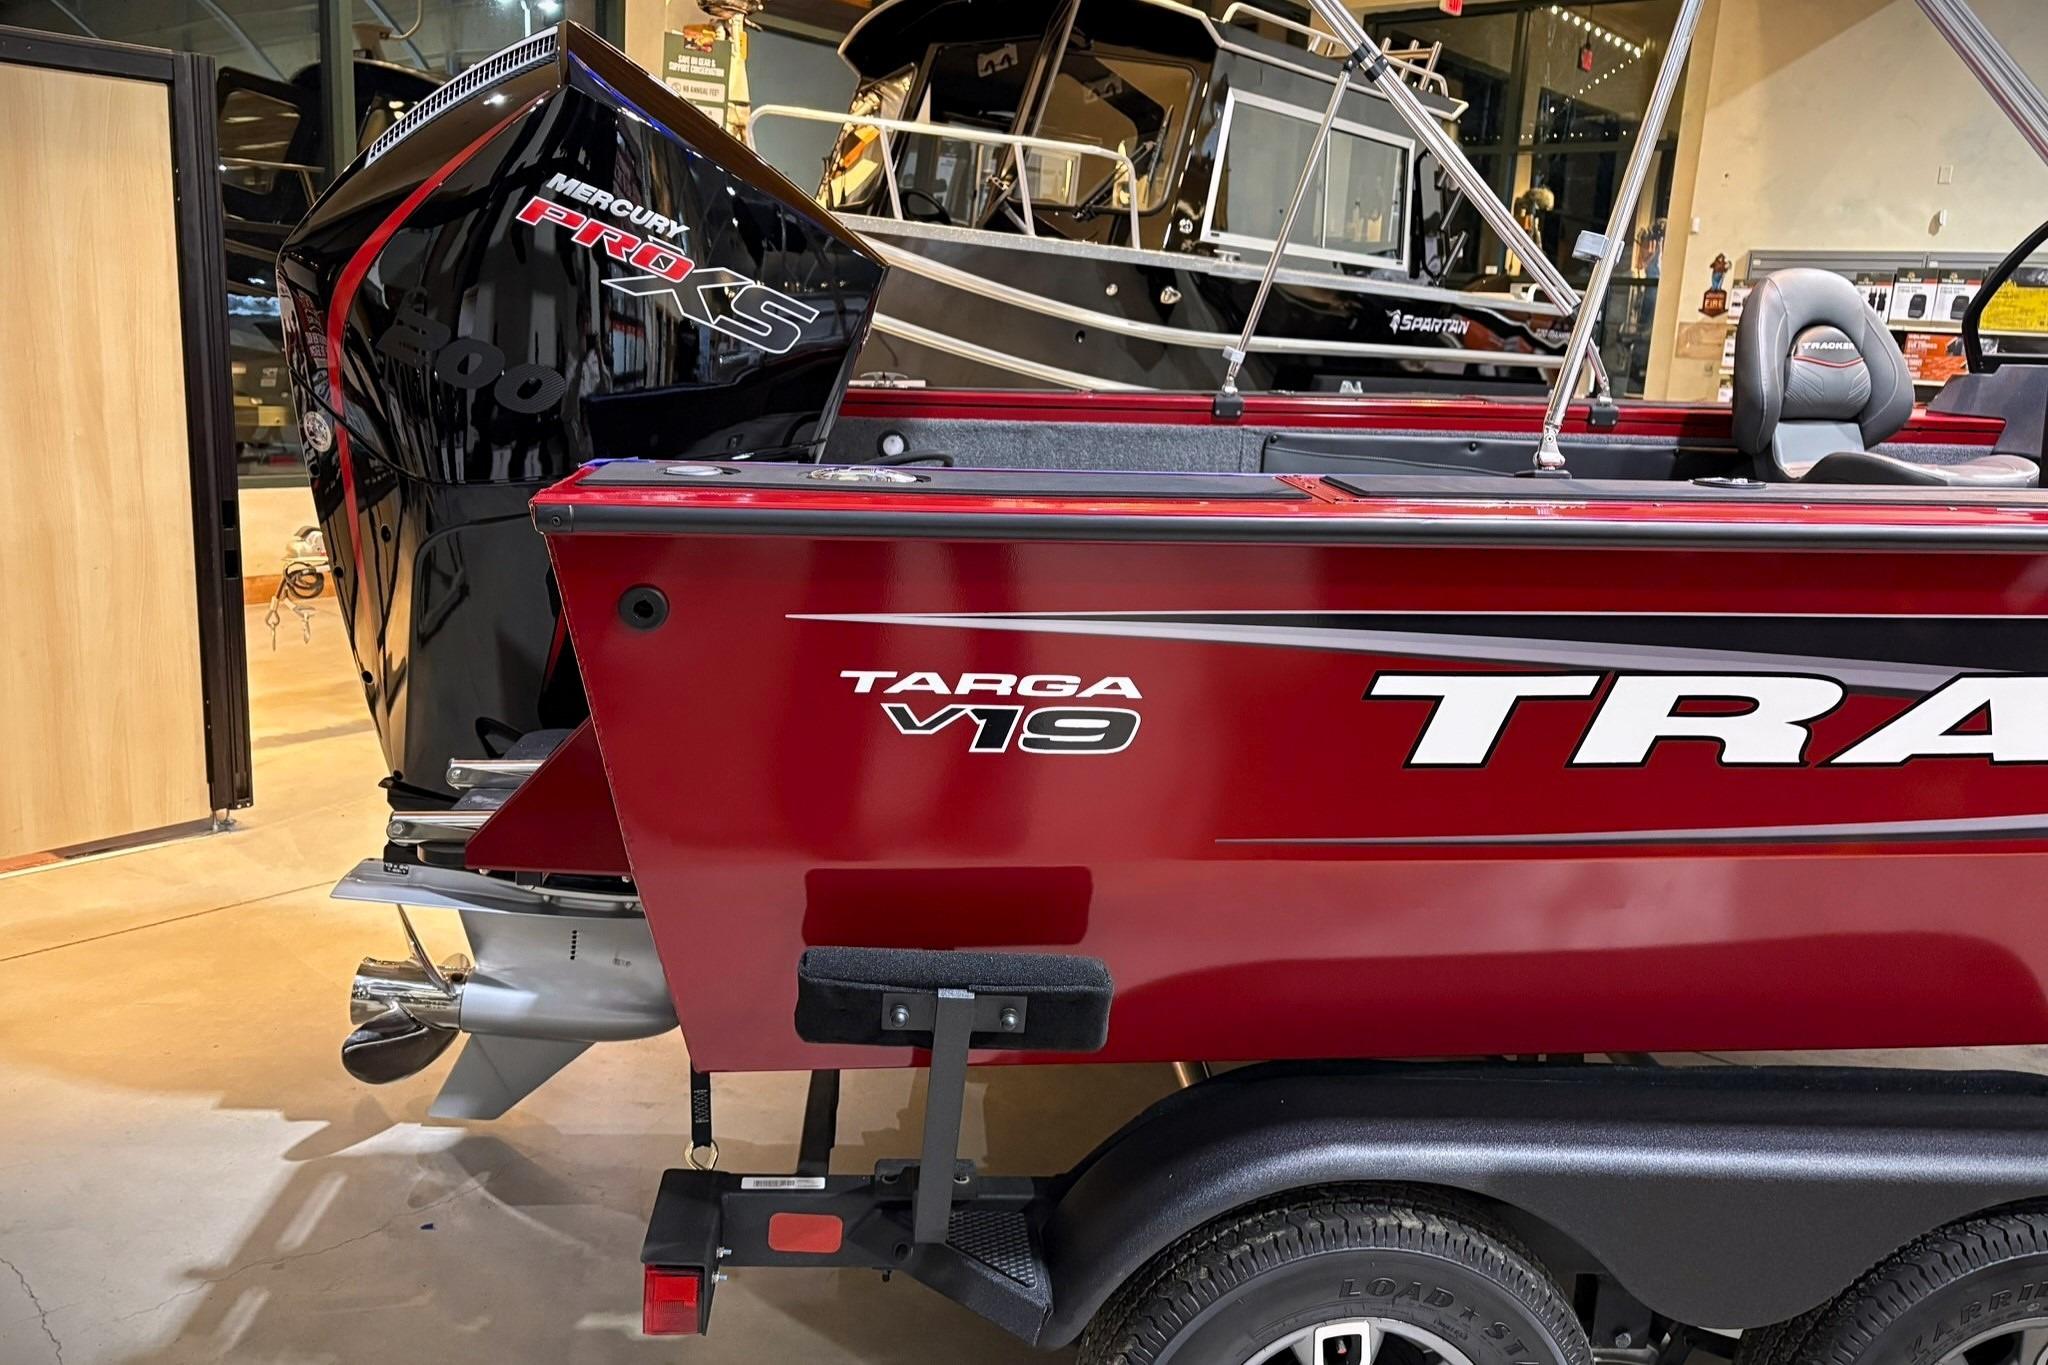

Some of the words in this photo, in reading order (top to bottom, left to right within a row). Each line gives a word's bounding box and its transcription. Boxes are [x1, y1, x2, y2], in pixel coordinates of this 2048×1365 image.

[516, 195, 695, 283] PRO
[546, 172, 691, 239] MERCURY
[601, 267, 820, 354] XS
[1400, 314, 1470, 335] SPARTAN
[840, 670, 1143, 699] TARGA
[880, 703, 1142, 755] V19
[1338, 1277, 1456, 1308] LOAD
[1483, 1321, 1540, 1365] ST
